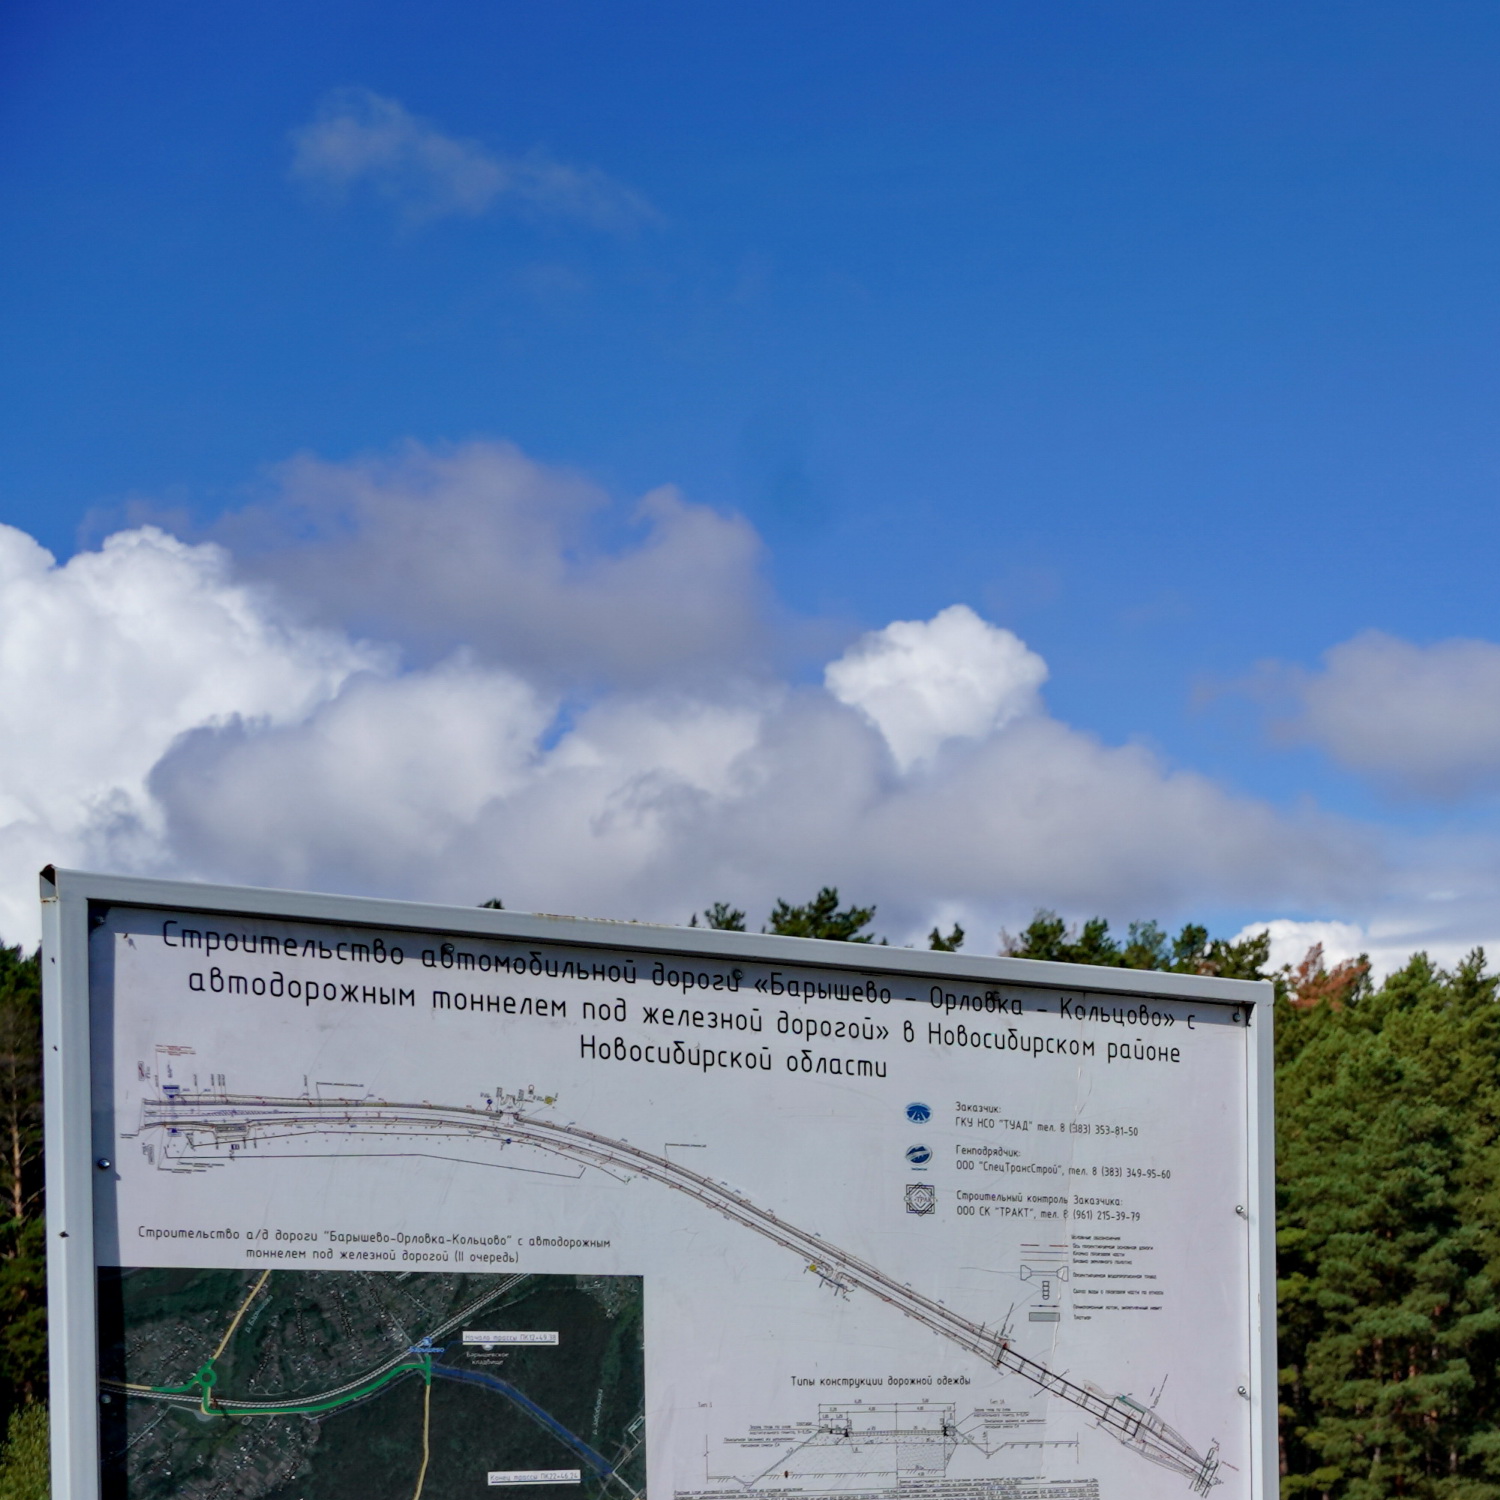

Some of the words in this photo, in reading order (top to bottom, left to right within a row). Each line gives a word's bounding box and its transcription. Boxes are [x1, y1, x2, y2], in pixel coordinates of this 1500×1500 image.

[162, 920, 405, 966] Строительство
[420, 944, 637, 984] автомобильной
[652, 962, 743, 1005] дороги
[754, 972, 891, 1005] «Барышево
[930, 987, 1023, 1016] Орловка
[1060, 998, 1175, 1031] Кольцово»
[1188, 1015, 1196, 1030] с
[188, 967, 416, 1010] автодорожным
[433, 989, 567, 1019] тоннелем
[582, 1000, 627, 1024] под
[643, 1002, 763, 1033] железной
[776, 1011, 889, 1050] дорогой»
[903, 1023, 915, 1043] в
[928, 1022, 1094, 1057] Новосибирском
[1106, 1040, 1181, 1064] районе
[580, 1035, 772, 1072] Новосибирской
[786, 1051, 888, 1078] области
[956, 1102, 1001, 1114] Заказчик:
[956, 1118, 974, 1126] ГКУ
[978, 1119, 995, 1128] НСО
[1037, 1123, 1056, 1132] тел.
[1060, 1123, 1065, 1132] 8
[1095, 1125, 1138, 1137] 353-81-50
[956, 1145, 1020, 1158] Генподрядчик:
[957, 1160, 974, 1170] ООО
[1092, 1167, 1097, 1175] 8
[1101, 1167, 1122, 1177] (383)
[1127, 1168, 1170, 1179] 349-95-60
[957, 1191, 1023, 1202] Строительный
[1027, 1193, 1068, 1204] контроль
[1074, 1195, 1123, 1207] Заказчика:
[957, 1206, 974, 1215] ООО
[979, 1207, 990, 1216] СК
[1041, 1210, 1060, 1218] тел.
[1073, 1210, 1093, 1221] (961)
[1097, 1211, 1140, 1221] 215-39-79
[138, 1226, 240, 1242] Строительство
[247, 1228, 269, 1242] а/д
[275, 1229, 318, 1246] дороги
[517, 1238, 523, 1247] с
[530, 1235, 610, 1251] автодорожным
[246, 1249, 306, 1260] тоннелем
[313, 1250, 335, 1262] под
[339, 1248, 396, 1262] железной
[402, 1250, 449, 1265] дорогой
[469, 1252, 519, 1265] очередь)
[791, 1376, 814, 1390] Типы
[820, 1375, 882, 1389] конструкции
[888, 1374, 932, 1389] дорожной
[936, 1373, 971, 1388] одежды
